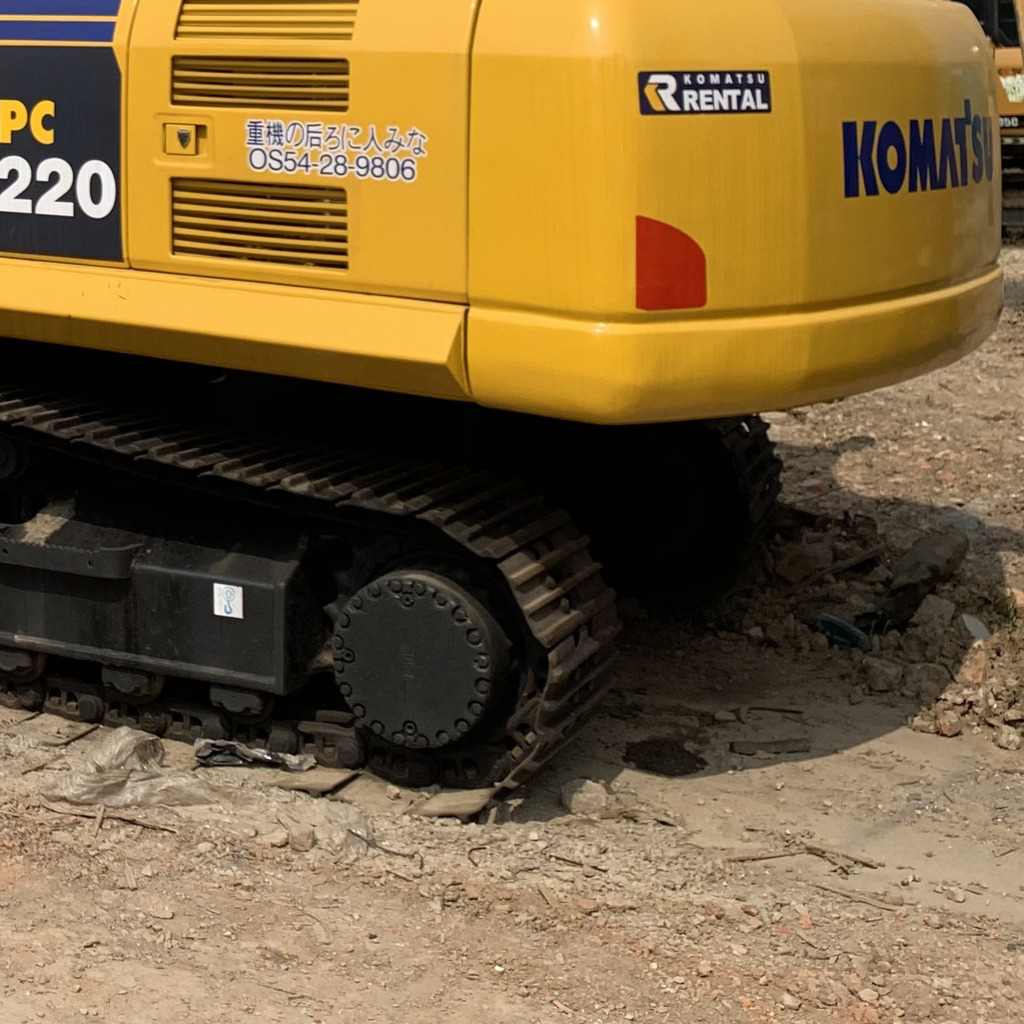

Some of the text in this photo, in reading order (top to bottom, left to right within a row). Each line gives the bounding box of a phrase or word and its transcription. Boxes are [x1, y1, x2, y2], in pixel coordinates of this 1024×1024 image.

[683, 74, 766, 84] KOMATSU
[682, 88, 769, 111] RENTAL
[842, 98, 994, 199] KOMATSU
